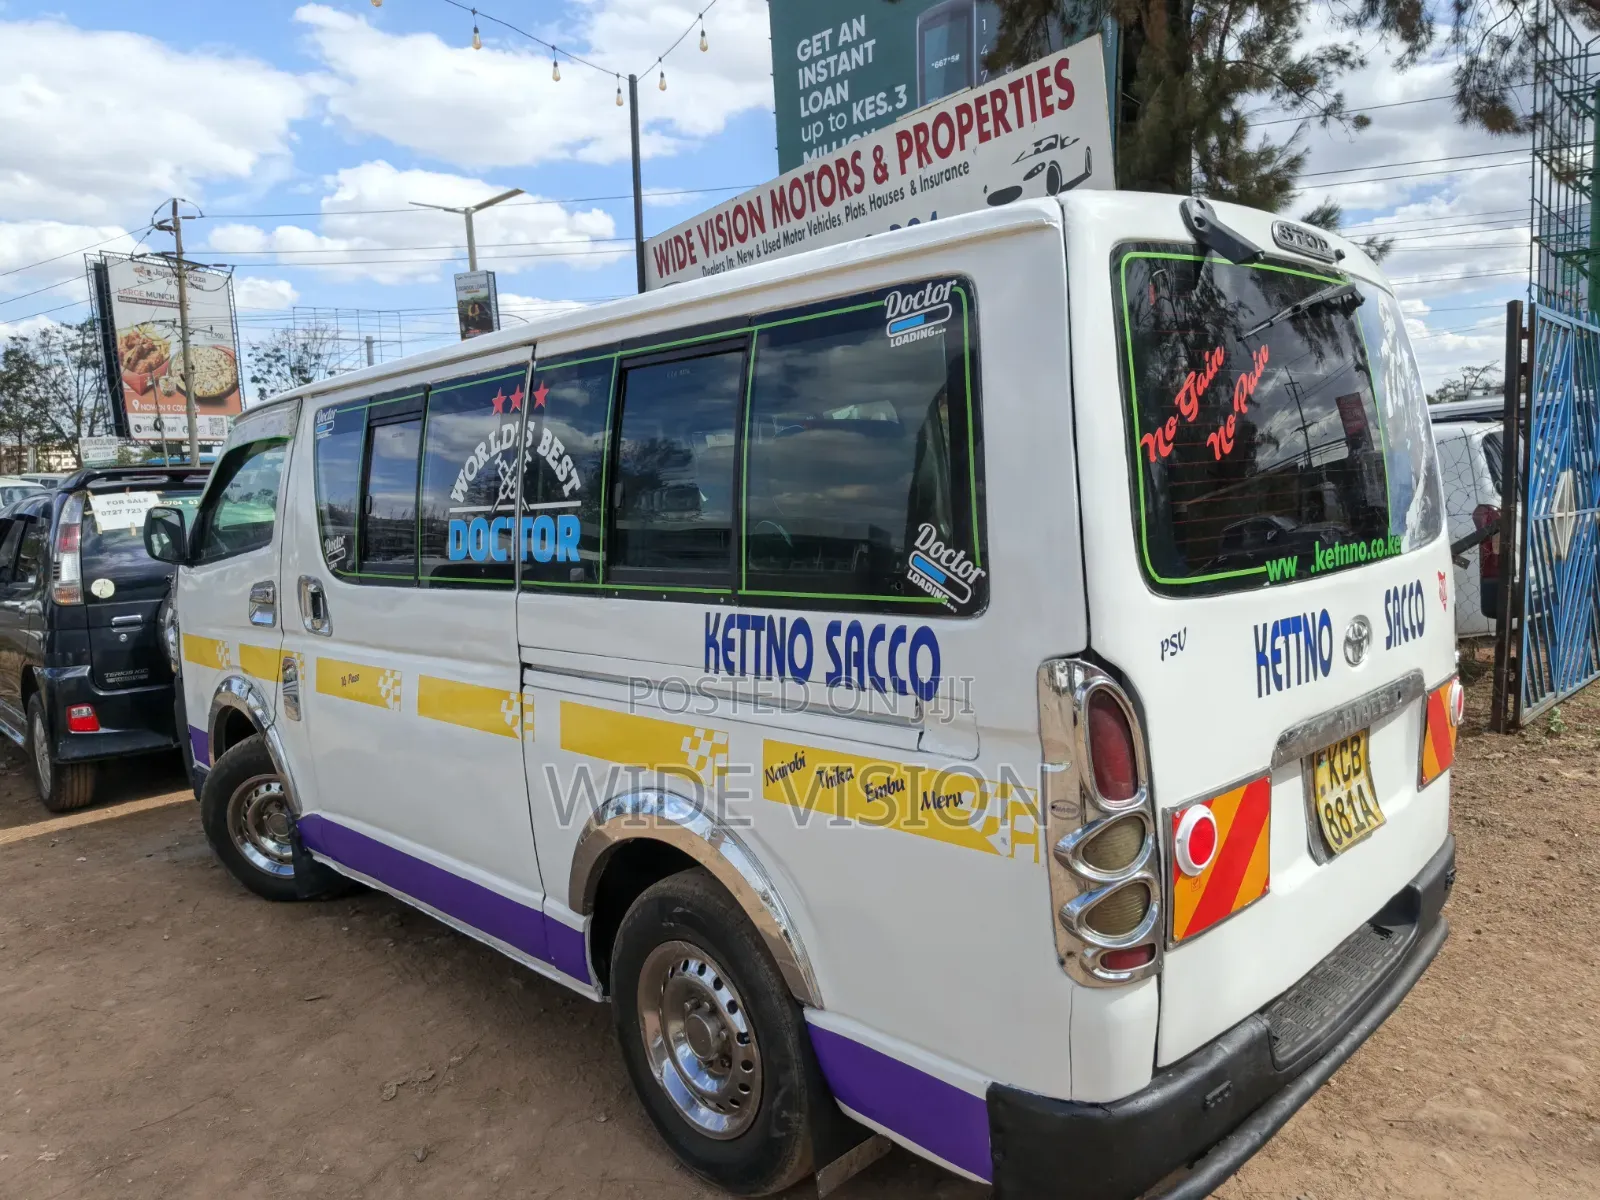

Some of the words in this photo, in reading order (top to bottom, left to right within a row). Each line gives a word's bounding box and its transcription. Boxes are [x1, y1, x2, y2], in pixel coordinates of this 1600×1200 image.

[797, 28, 833, 61] GET
[838, 14, 866, 46] AN
[798, 39, 876, 90] INSTANT
[800, 80, 849, 118] LOAN
[801, 121, 824, 144] up
[828, 112, 847, 132] to
[852, 91, 893, 125] KES.
[895, 84, 908, 109] 3
[653, 229, 697, 278] WIDE
[697, 196, 766, 259] VISION
[770, 150, 865, 229] MOTORS
[872, 144, 889, 185] &
[896, 57, 1075, 175] PROPERTIES
[702, 256, 725, 277] Dealers
[736, 247, 755, 266] New
[756, 244, 762, 258] &
[762, 233, 782, 255] Used
[783, 223, 806, 247] Motor
[844, 201, 868, 224] Plots,
[868, 187, 905, 213] Houses
[910, 179, 917, 196] &
[919, 160, 970, 193] Insurance
[1279, 225, 1329, 252] STOP
[118, 288, 145, 298] LARGE
[146, 292, 175, 301] MUNCH
[884, 279, 957, 319] Doctor
[891, 326, 946, 348] LOADING...
[1140, 414, 1179, 462] No
[1174, 346, 1224, 422] Gain
[1206, 411, 1237, 460] No
[1233, 344, 1269, 414] Pain
[450, 421, 535, 502] WORLD'S
[537, 427, 581, 498] BEST
[101, 509, 122, 517] 0727
[448, 514, 581, 562] DOCTOR
[325, 535, 346, 554] Doctor
[914, 523, 986, 584] Doctor
[704, 612, 814, 684] KETTNO
[825, 619, 941, 701] SACCO
[1253, 608, 1334, 699] KETTNO
[1384, 579, 1425, 651] SACCO
[1341, 693, 1391, 734] HIACE
[764, 750, 807, 787] Nairobi
[815, 766, 855, 790] Thika
[864, 775, 906, 803] Embu
[919, 791, 964, 812] Meru
[1328, 735, 1362, 791] KCB
[1324, 784, 1379, 846] 881A
